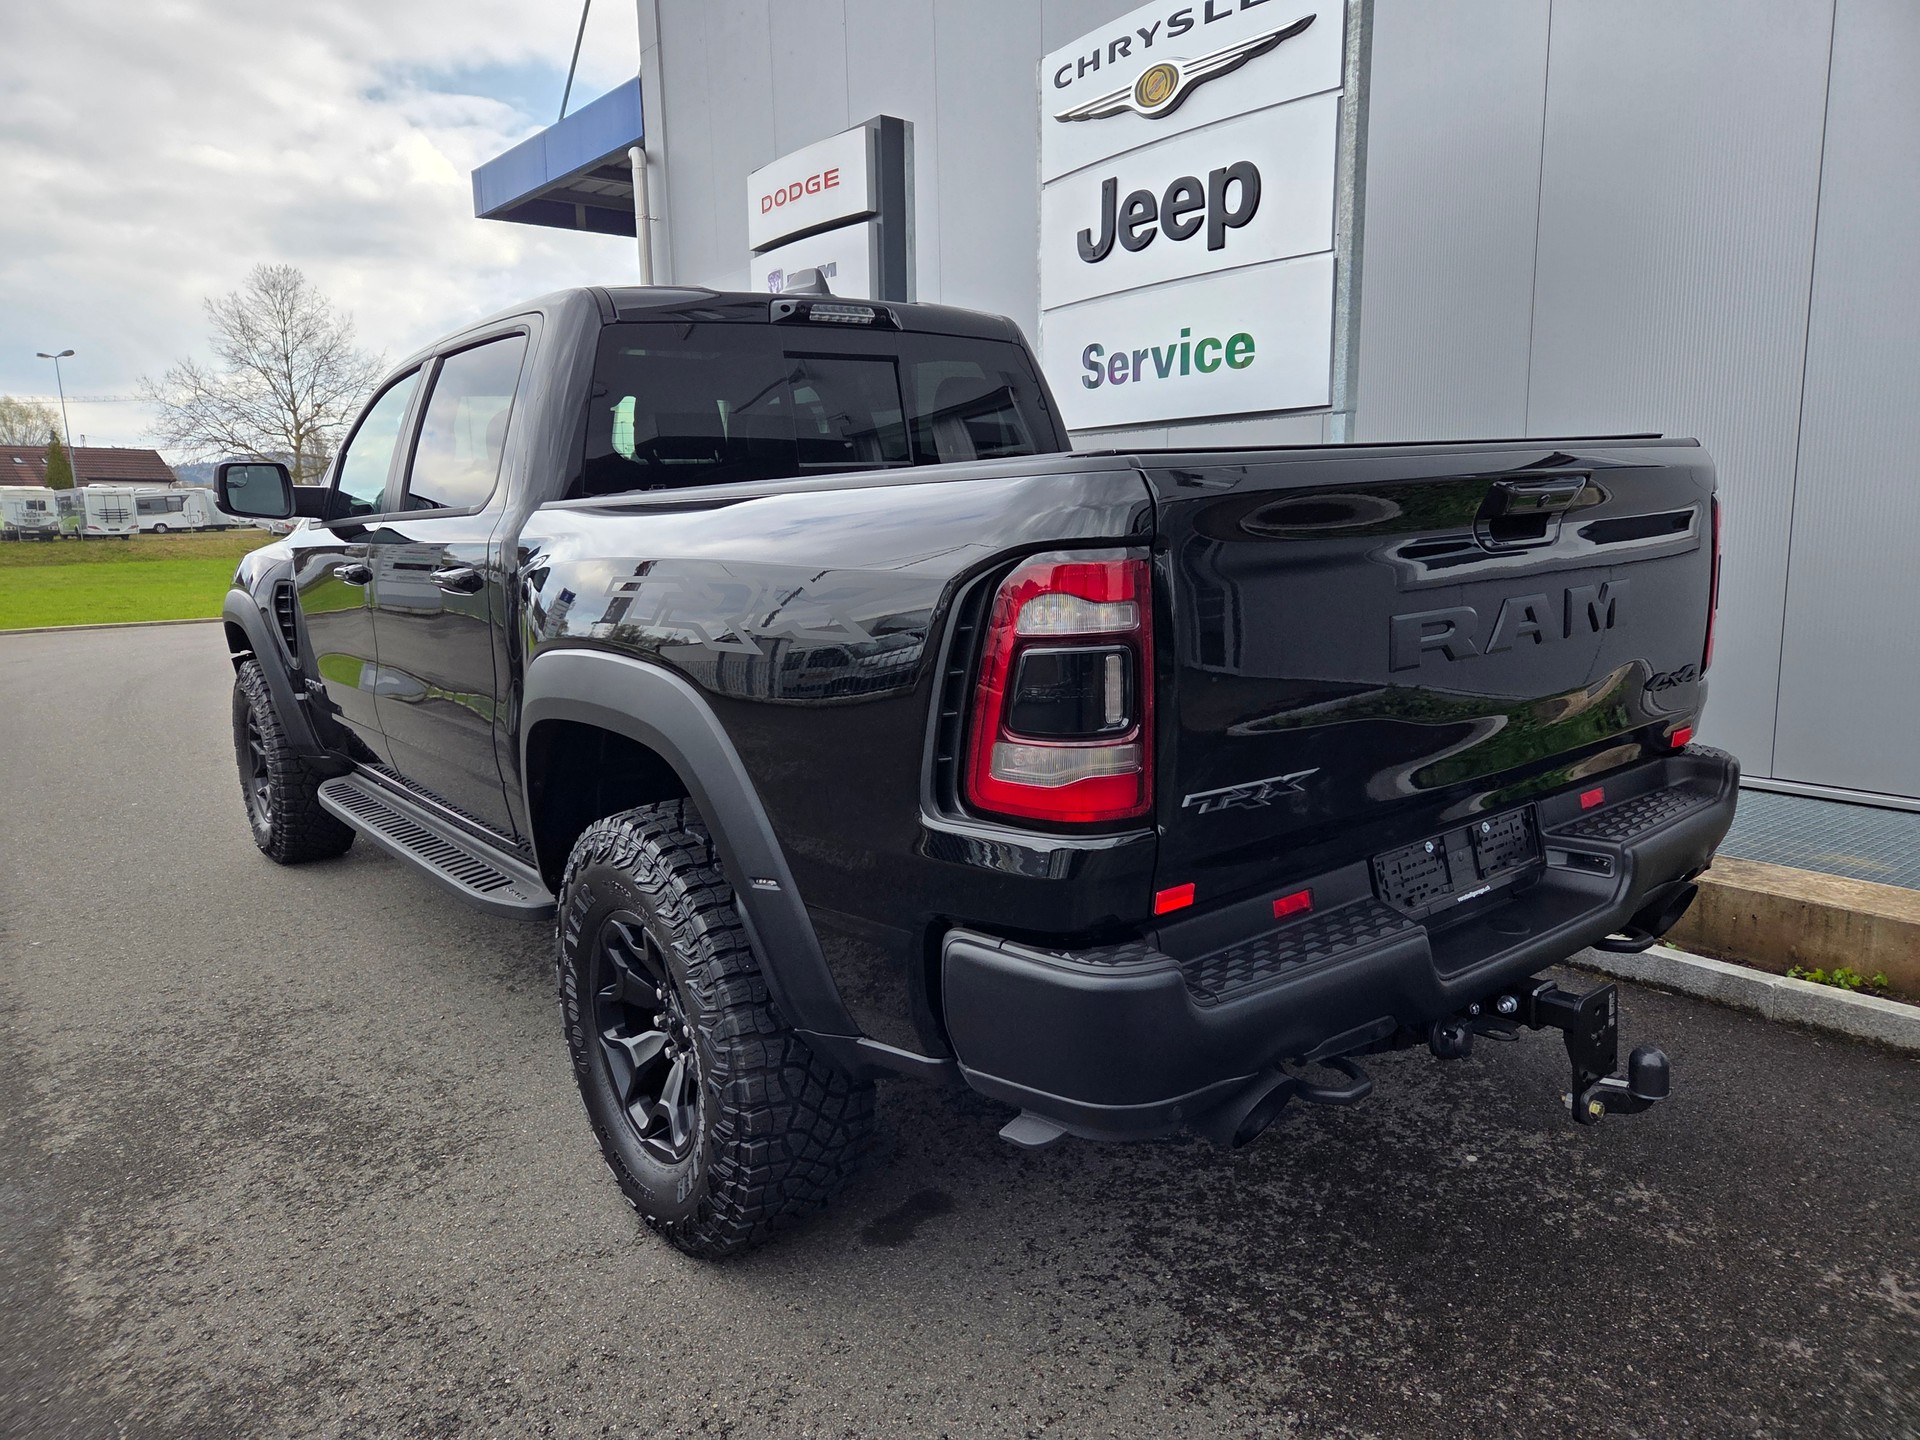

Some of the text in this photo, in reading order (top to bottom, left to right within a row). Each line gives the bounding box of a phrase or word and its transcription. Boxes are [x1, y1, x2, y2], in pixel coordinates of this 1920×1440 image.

[761, 167, 840, 214] DODGE
[1076, 159, 1262, 264] Jeep
[1081, 327, 1256, 390] Service
[1389, 578, 1630, 673] RAM
[1181, 767, 1320, 815] TRX
